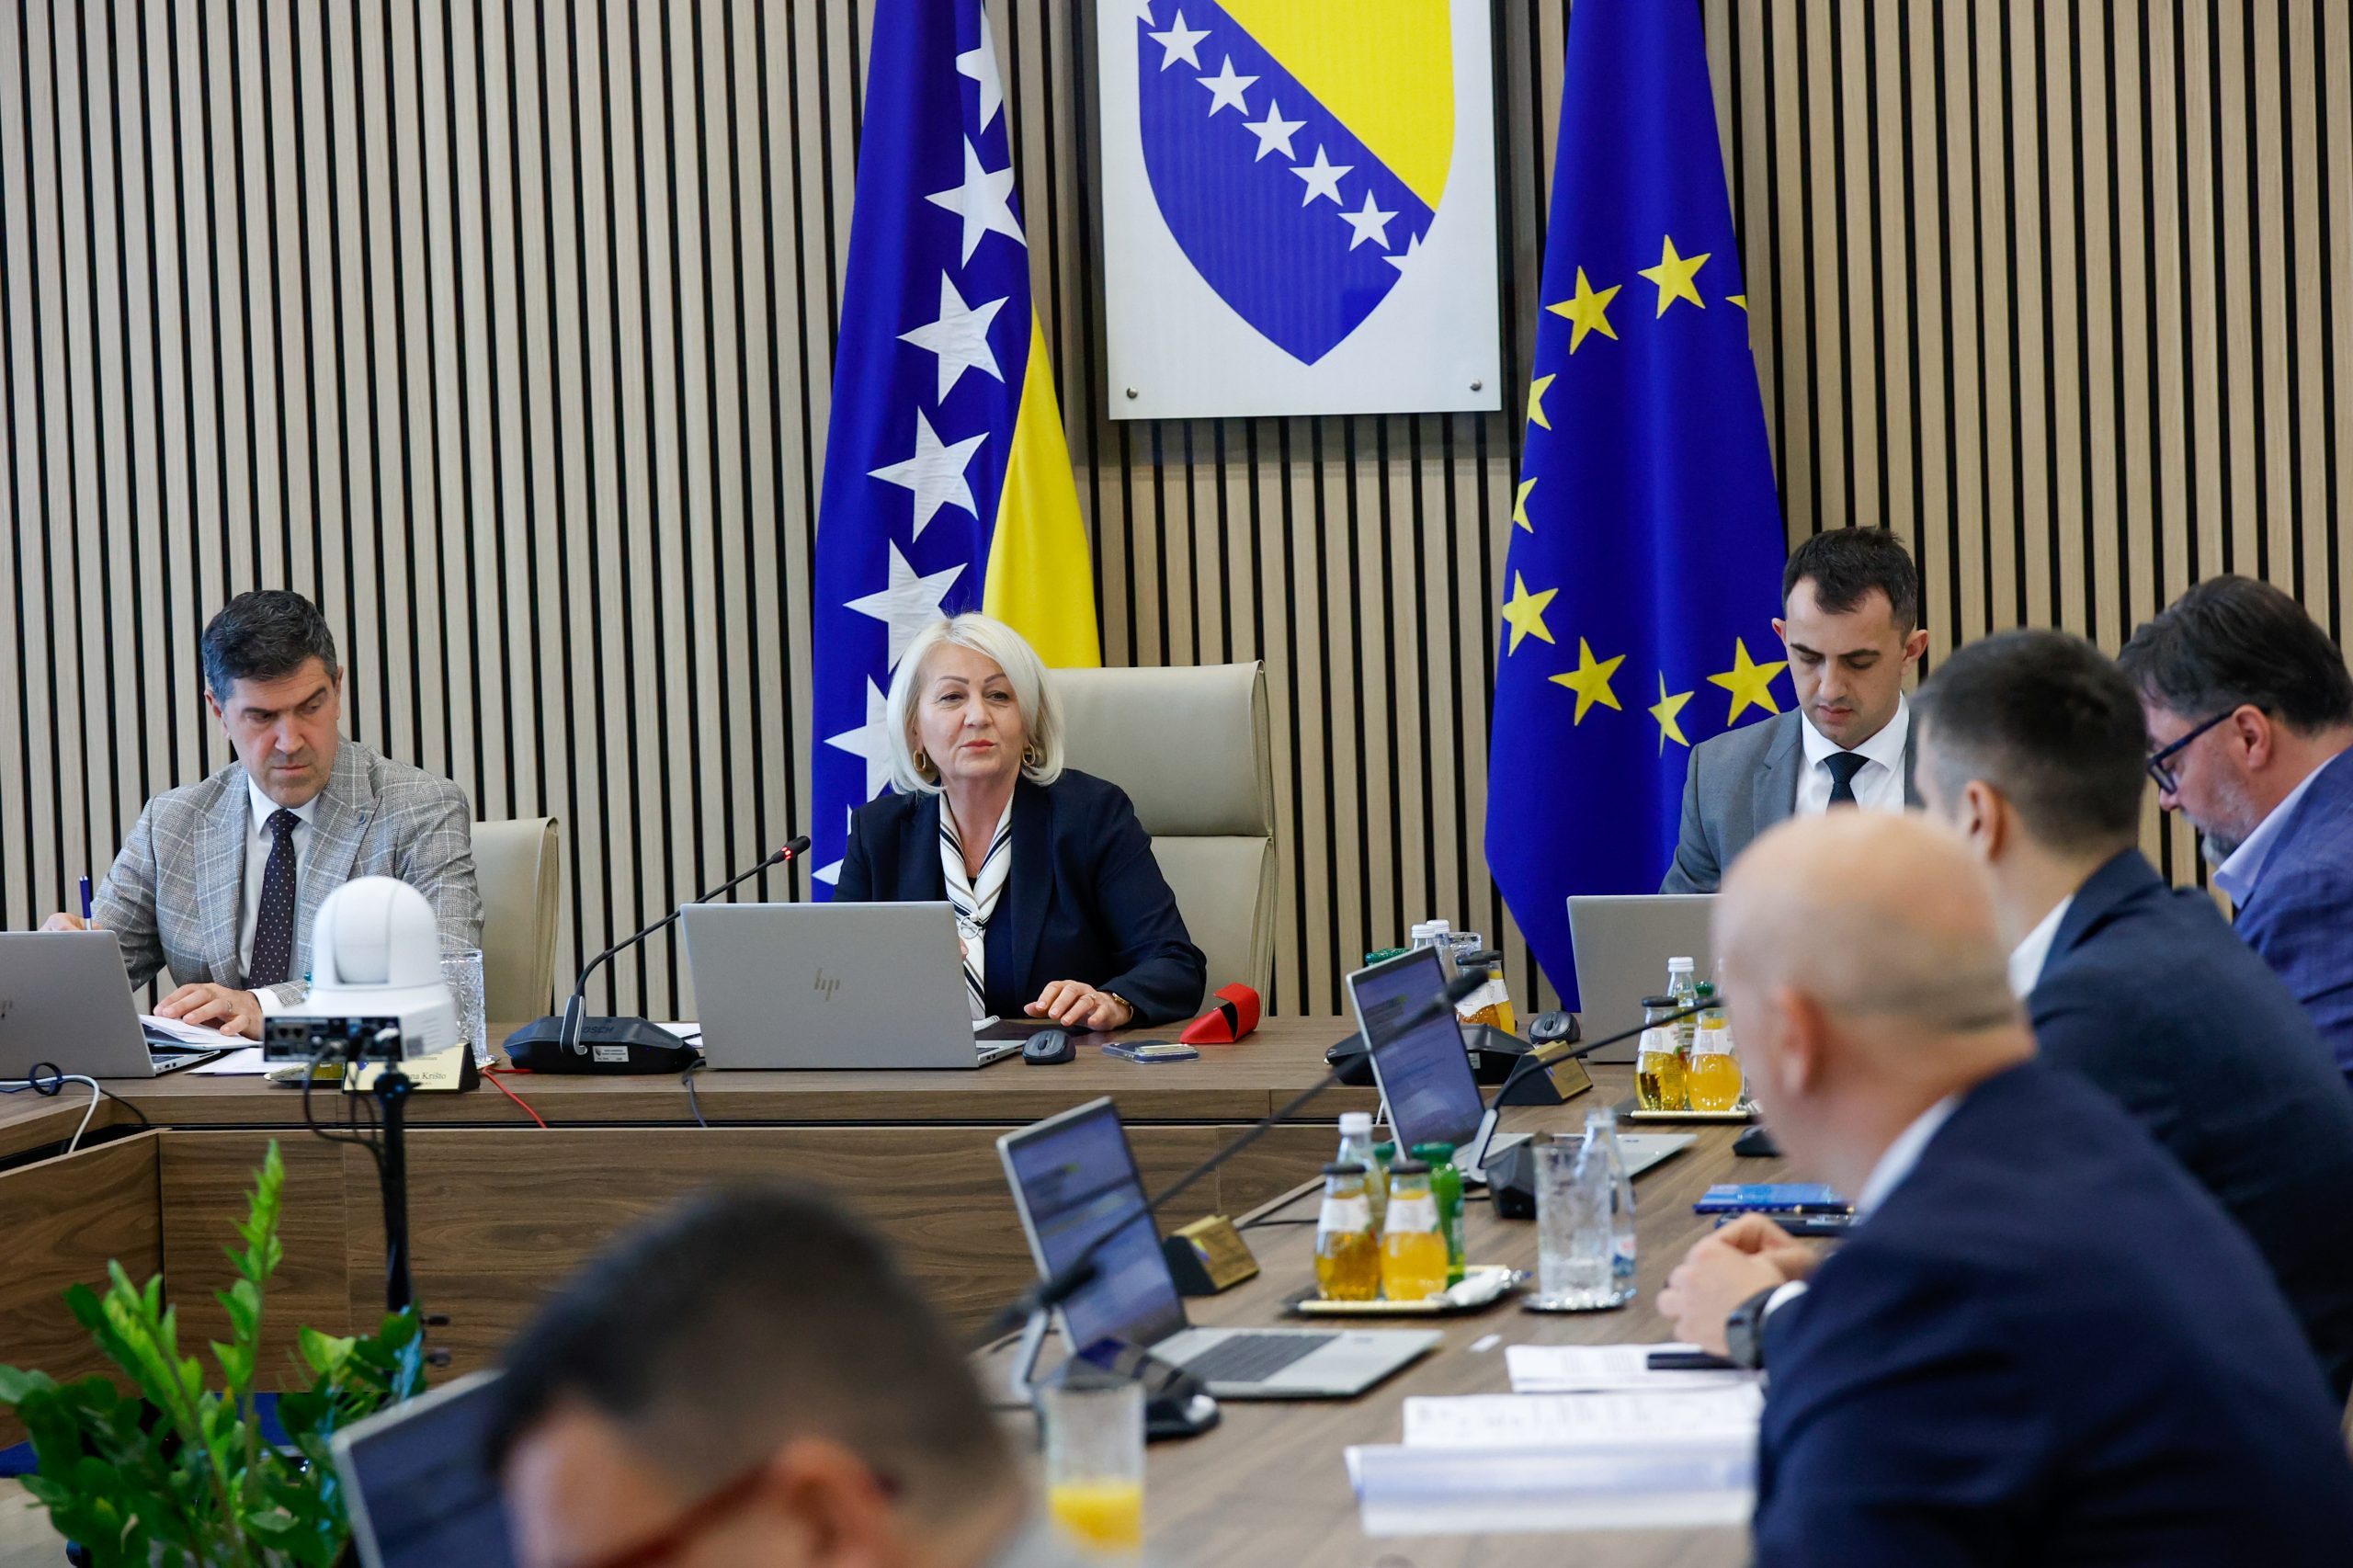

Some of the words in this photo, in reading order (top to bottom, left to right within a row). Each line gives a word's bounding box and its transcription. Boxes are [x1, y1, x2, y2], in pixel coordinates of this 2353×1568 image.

[814, 968, 840, 1001] hp
[582, 1026, 615, 1034] OSCH
[422, 1071, 447, 1080] Krišto
